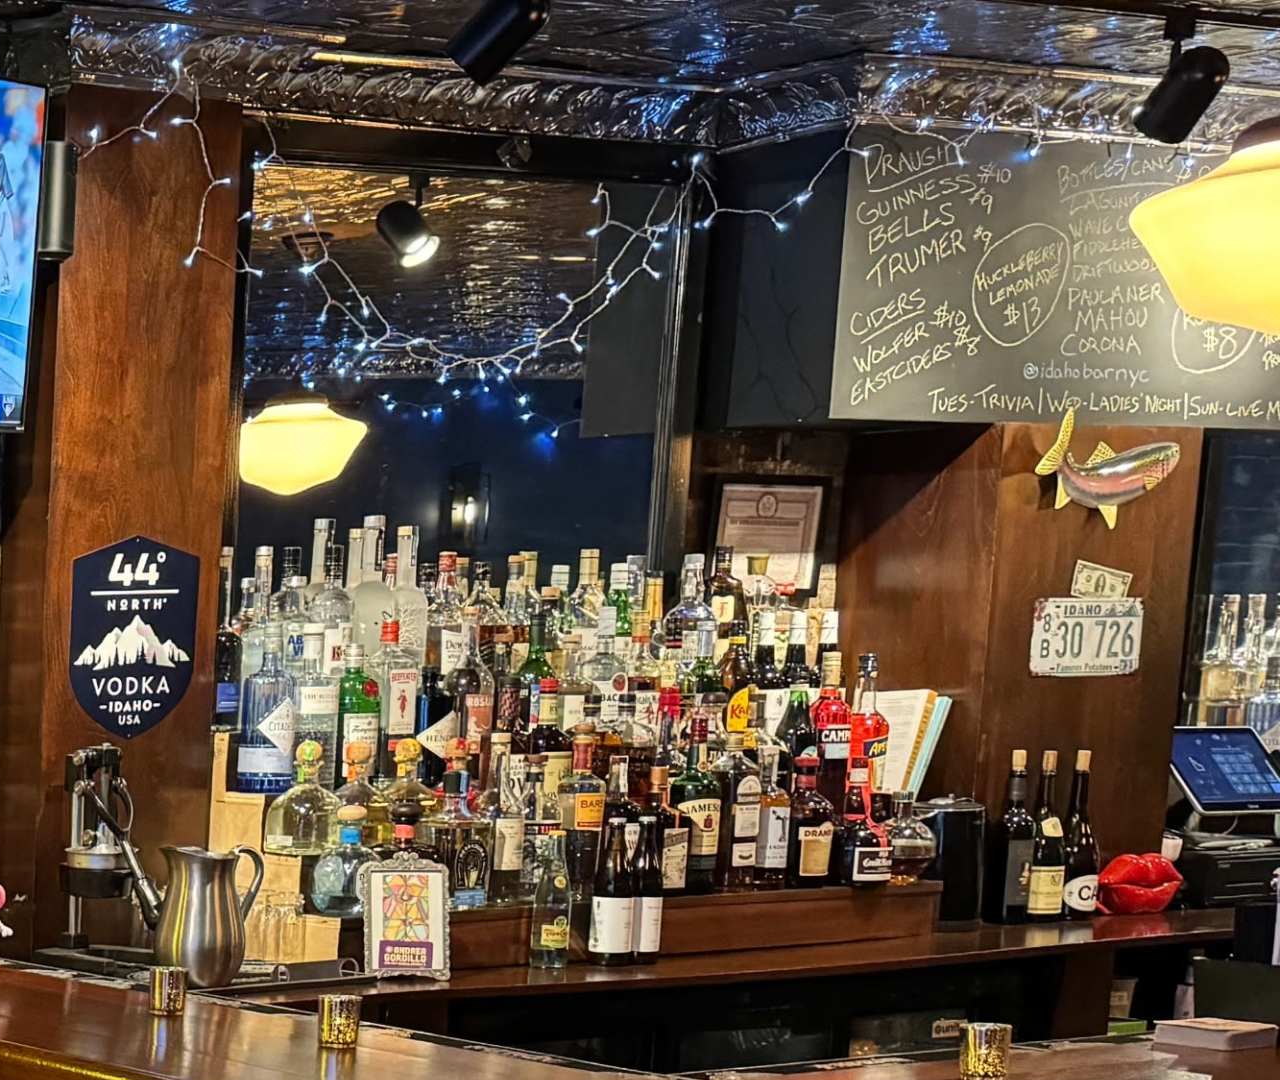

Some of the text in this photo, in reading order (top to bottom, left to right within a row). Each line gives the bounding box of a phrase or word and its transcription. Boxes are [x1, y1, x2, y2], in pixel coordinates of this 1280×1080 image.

[856, 163, 1012, 225] GUINNESS $10
[868, 203, 956, 255] BELLS
[866, 229, 967, 288] TRUMER
[975, 240, 1066, 291] HUCKLEBERRY
[987, 268, 1060, 306] LEMONADE
[1068, 282, 1166, 311] PAULANER
[849, 288, 927, 336] CIDERS
[929, 300, 967, 328] $10
[1003, 302, 1042, 333] $13
[1075, 307, 1149, 333] MAHOU
[1060, 333, 1142, 356] CORONA
[1203, 327, 1237, 360] $8
[1023, 360, 1151, 389] @idahobarnyc
[1042, 613, 1052, 633] 8
[1063, 604, 1102, 615] IDAHO
[1040, 639, 1050, 658] B
[1055, 620, 1134, 658] 30 726
[92, 675, 170, 697] VODKA
[118, 714, 141, 725] USA
